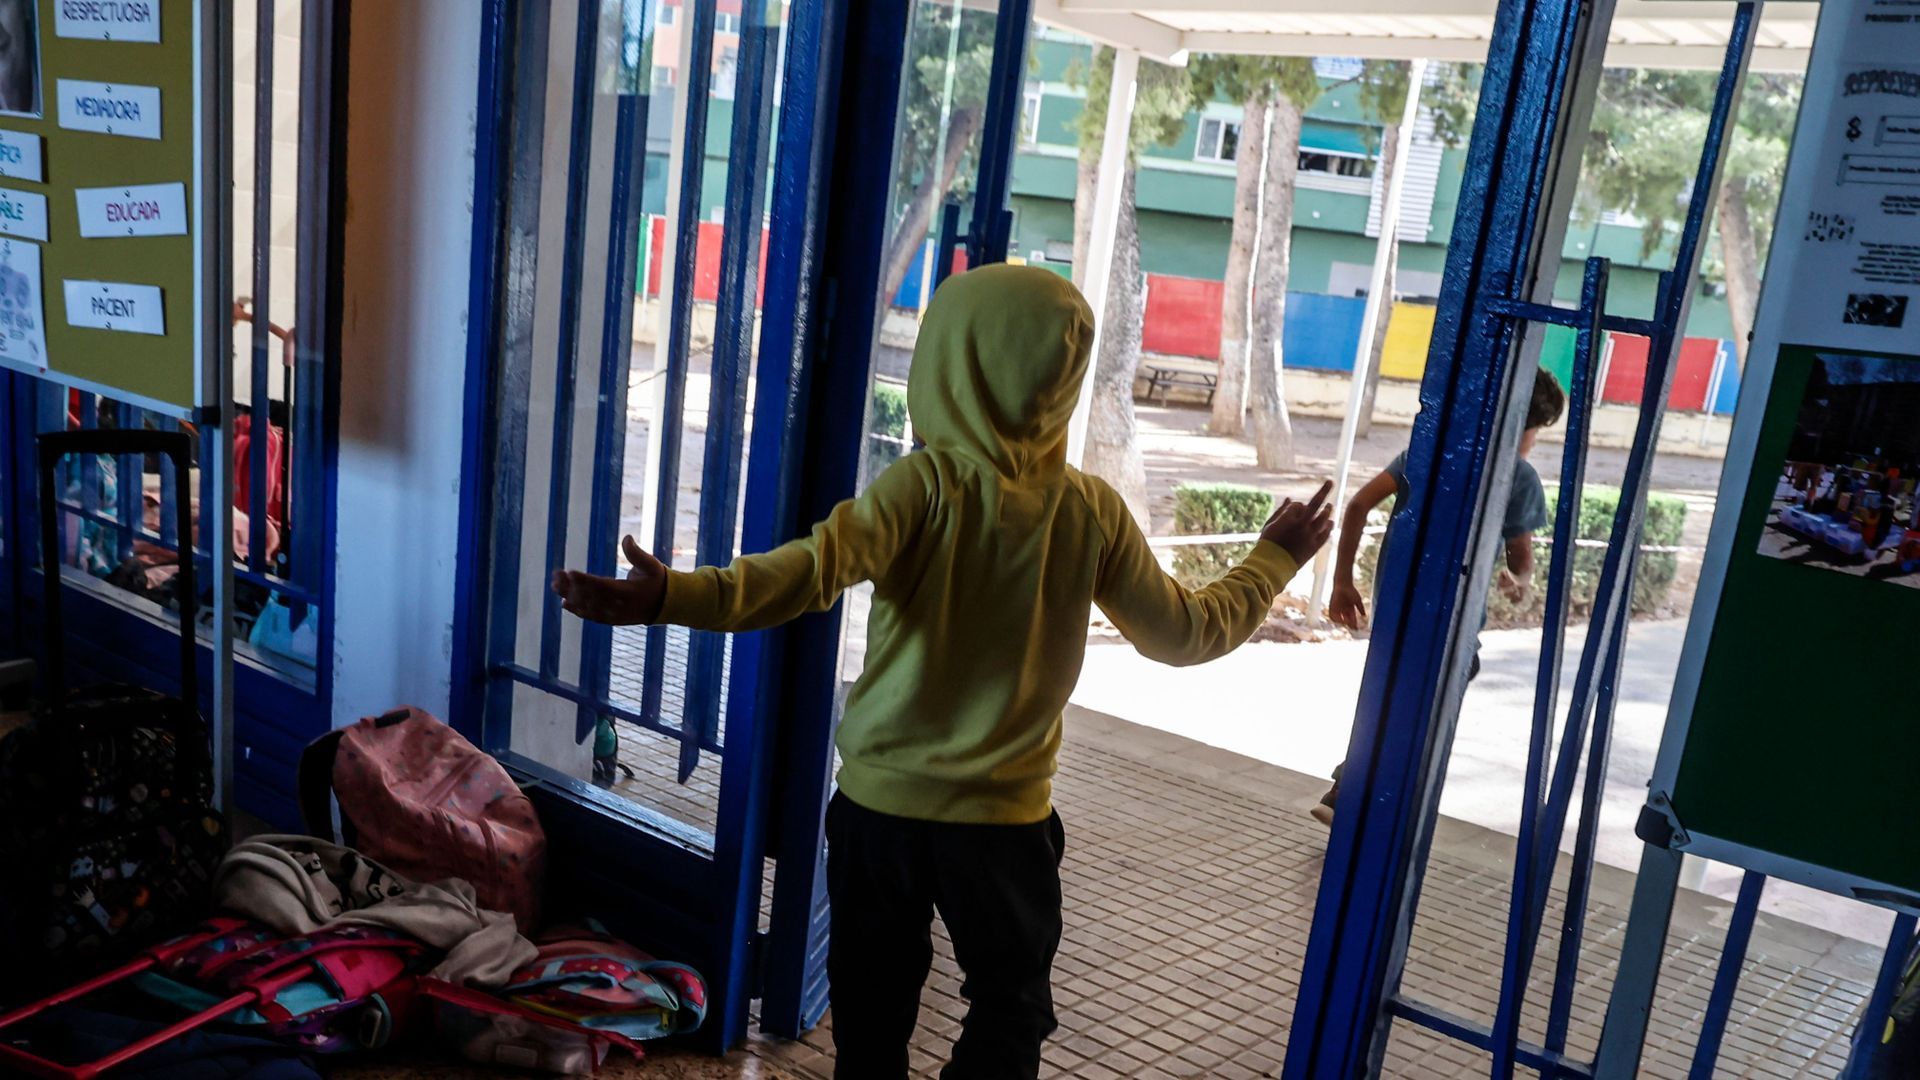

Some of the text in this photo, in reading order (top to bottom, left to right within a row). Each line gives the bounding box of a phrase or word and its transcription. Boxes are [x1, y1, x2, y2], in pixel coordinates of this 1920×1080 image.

[63, 0, 151, 22] RESPECTUOSA
[75, 96, 141, 121] MEDIADORA
[105, 201, 161, 222] EDUCADA
[91, 296, 136, 318] PACIENT
